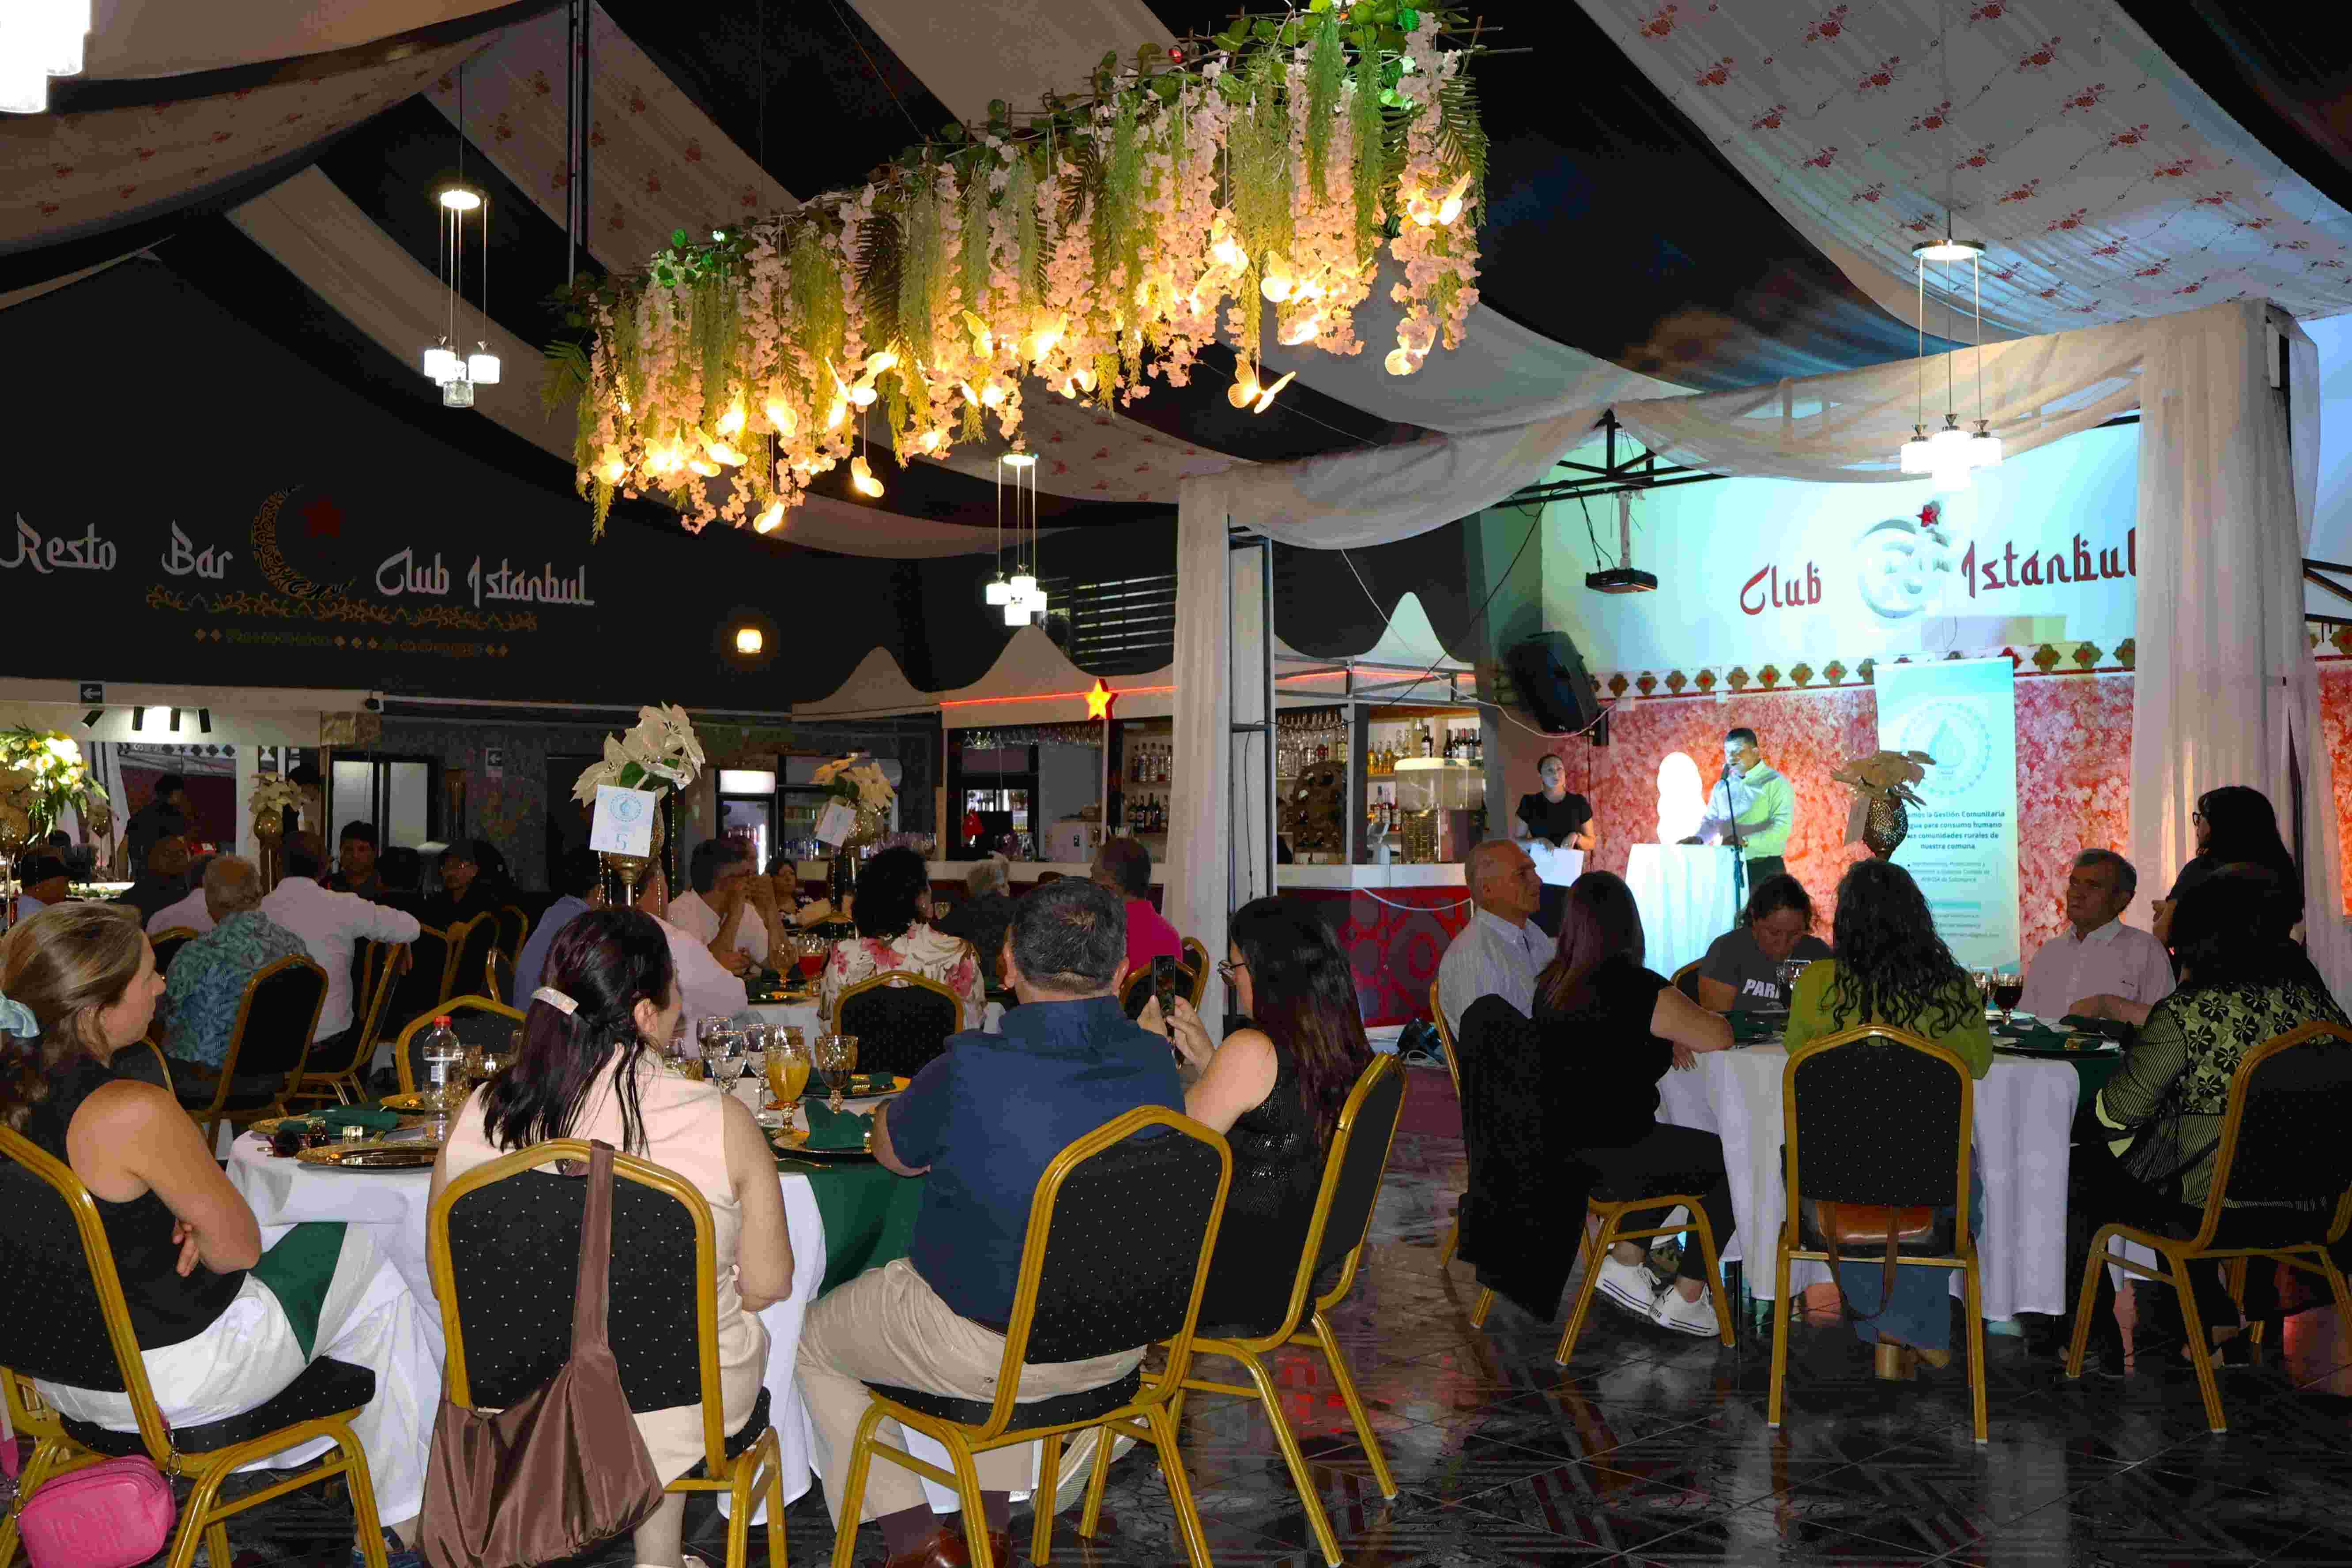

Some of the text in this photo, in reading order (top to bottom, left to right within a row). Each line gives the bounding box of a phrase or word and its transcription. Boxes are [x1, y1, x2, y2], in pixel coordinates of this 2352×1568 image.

[0, 512, 234, 579] Resto Bar
[376, 546, 595, 608] Club Istanbul
[1740, 527, 2137, 615] Club Istanbul
